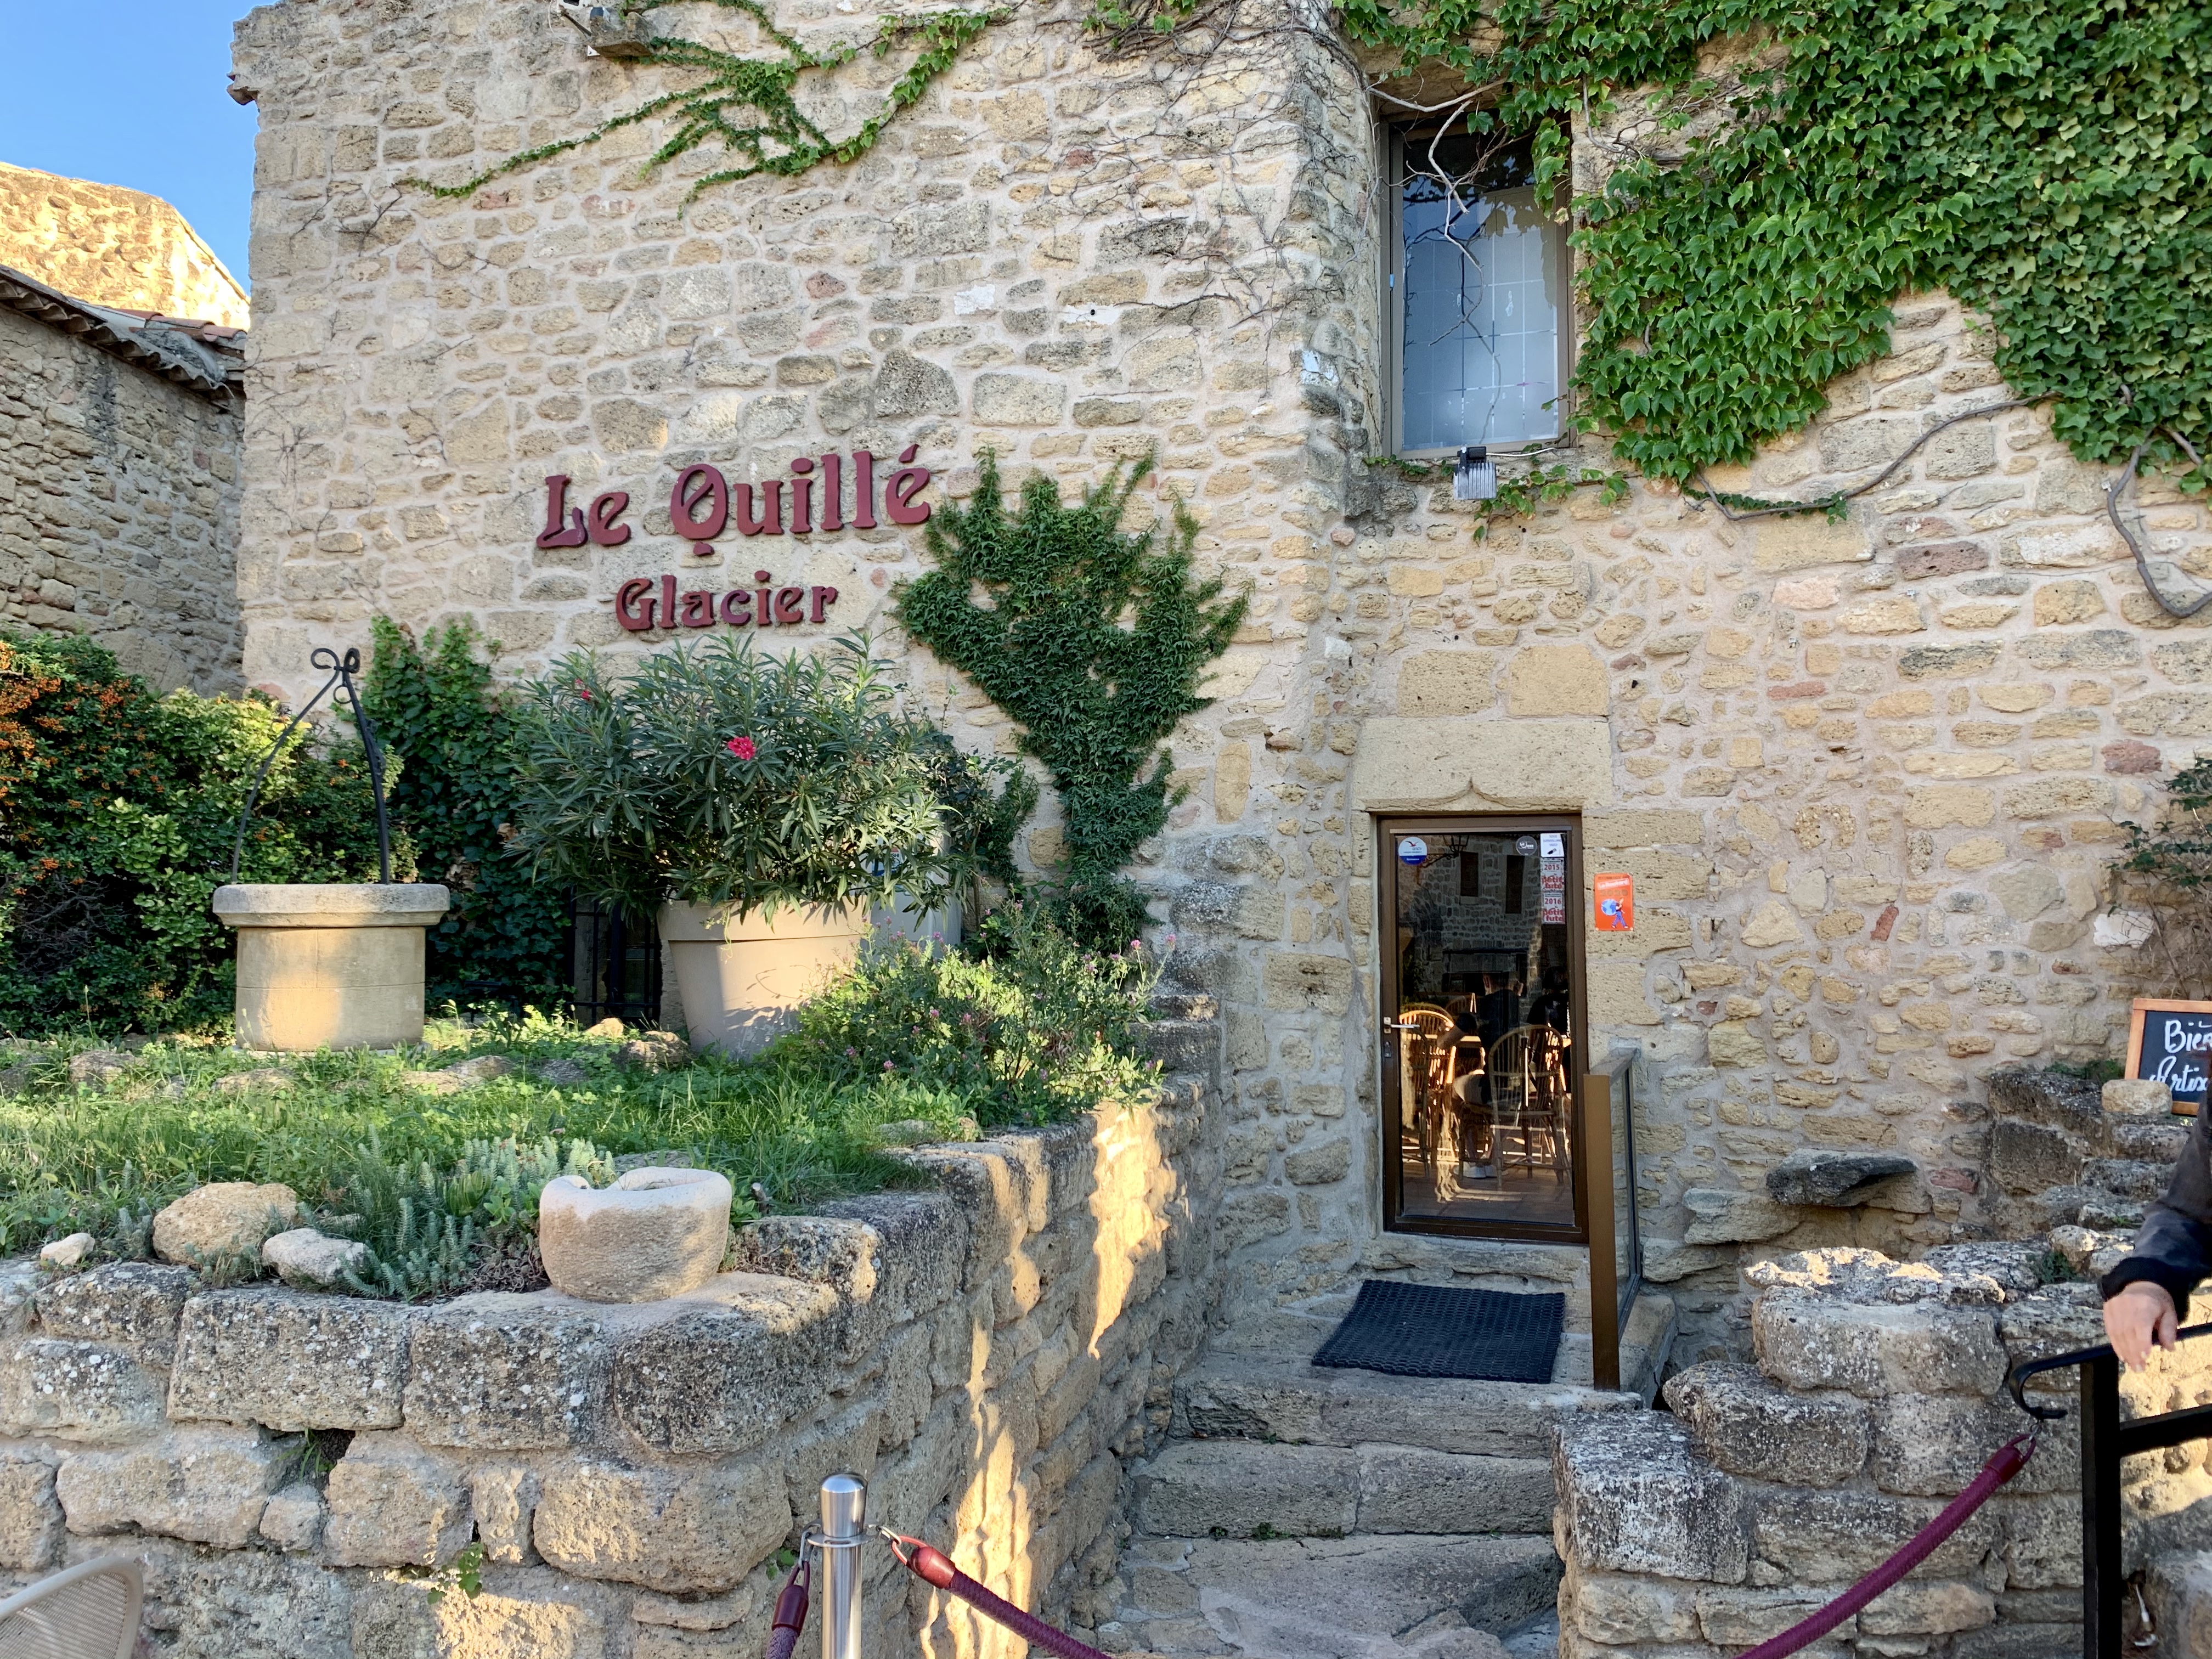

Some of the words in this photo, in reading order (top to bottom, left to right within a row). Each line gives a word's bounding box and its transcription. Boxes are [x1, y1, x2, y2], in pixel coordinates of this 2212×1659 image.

[536, 475, 631, 548] Le
[670, 443, 931, 556] Quillé
[615, 570, 838, 631] Glacier
